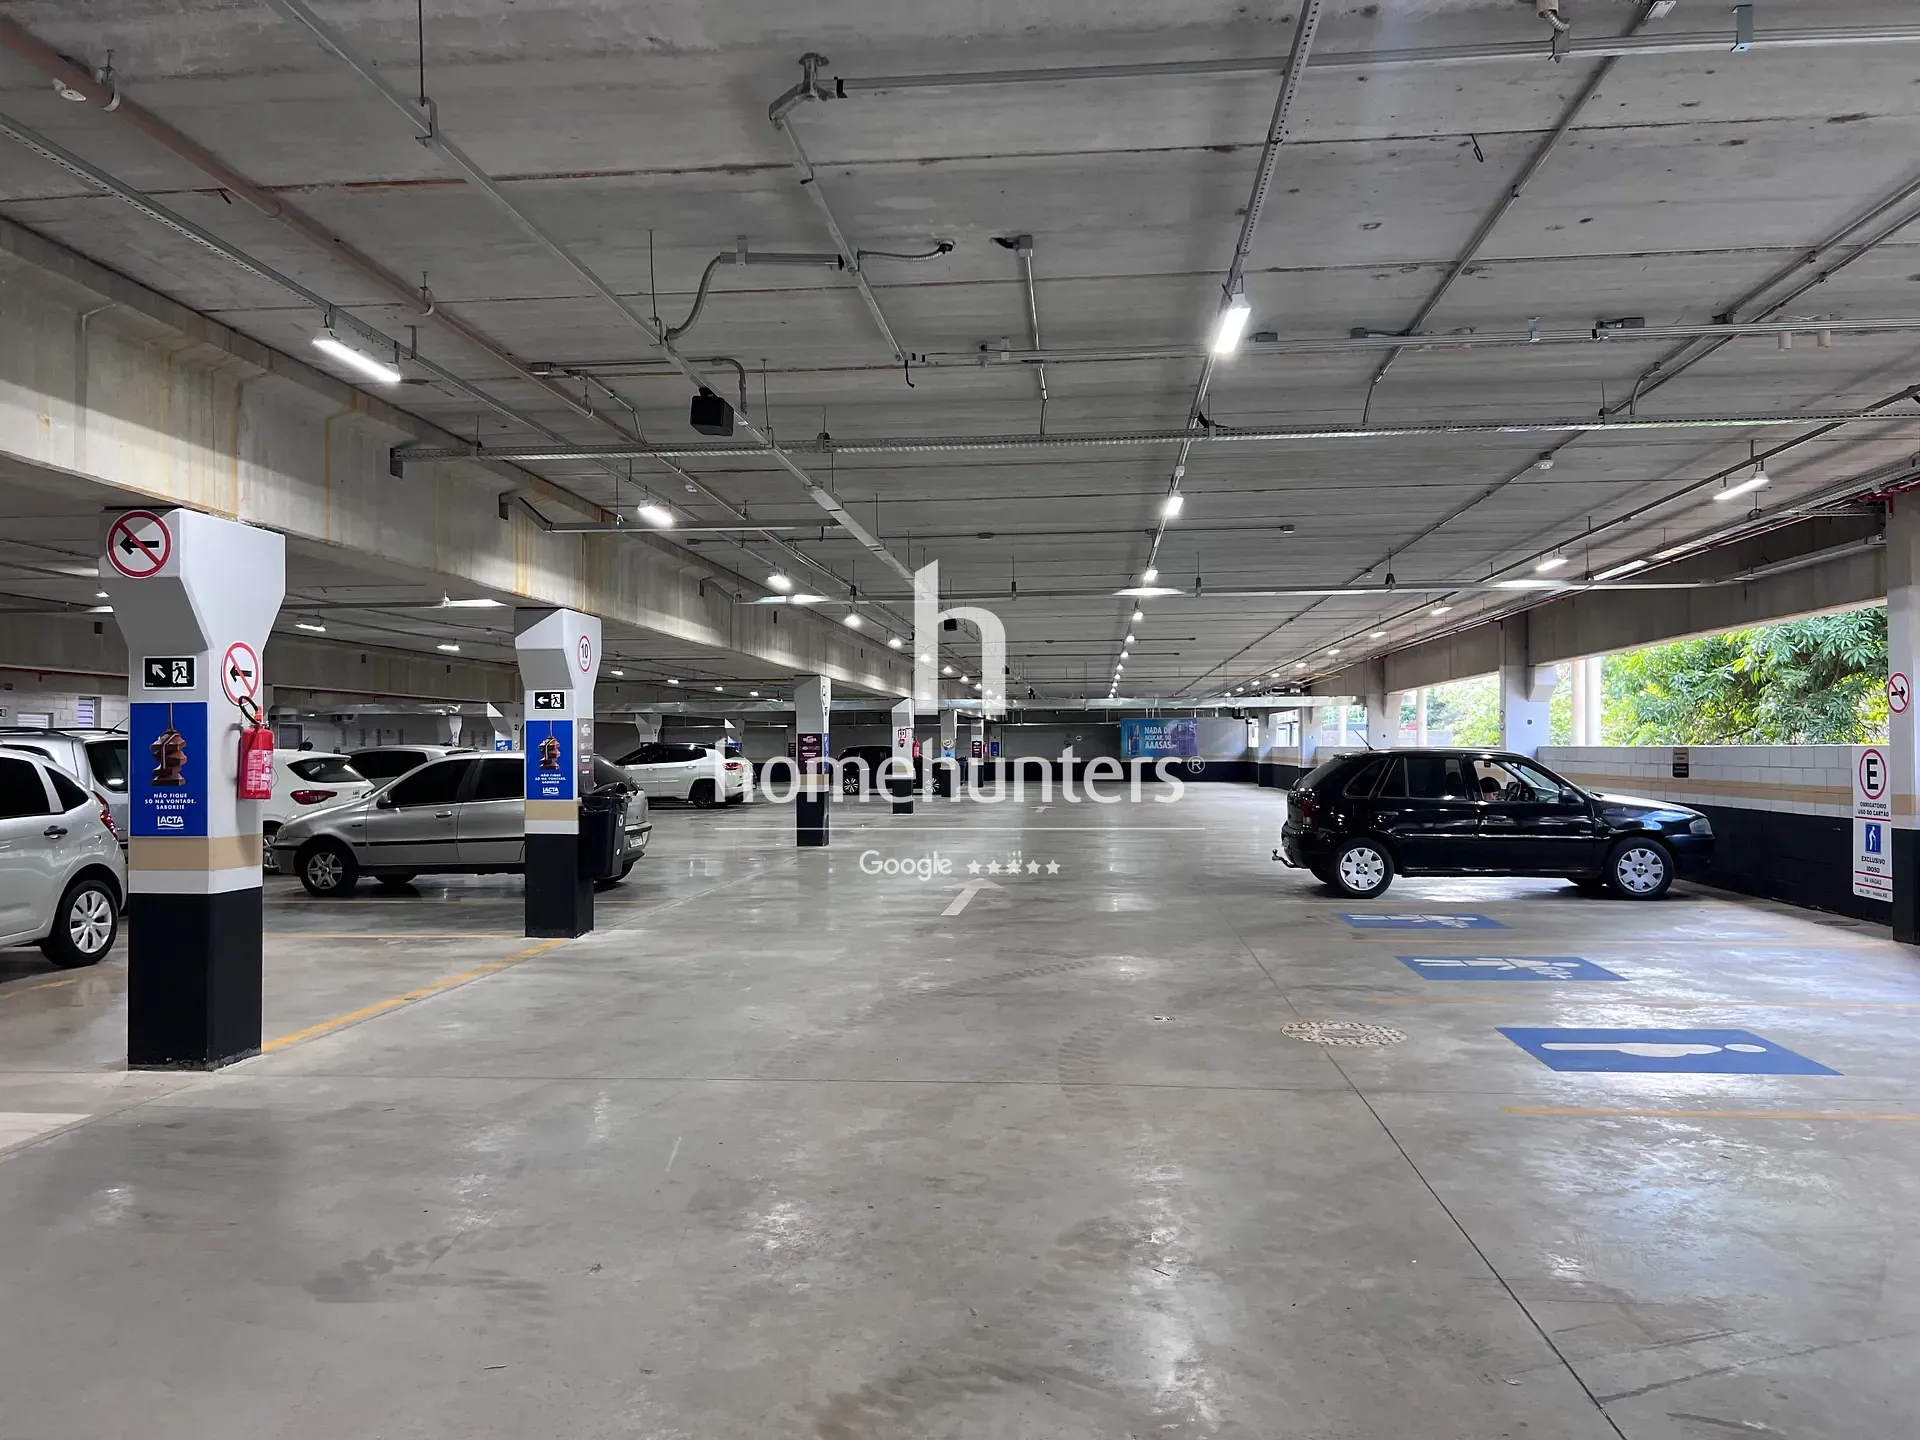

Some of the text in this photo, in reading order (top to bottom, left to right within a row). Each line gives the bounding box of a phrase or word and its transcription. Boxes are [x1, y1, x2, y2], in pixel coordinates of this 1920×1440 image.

[581, 643, 589, 659] 10
[1144, 726, 1161, 734] NADA
[1866, 758, 1879, 790] E
[157, 815, 185, 828] LACTA
[1861, 855, 1886, 865] EXCLUSIVO
[1866, 865, 1881, 874] IDOSO
